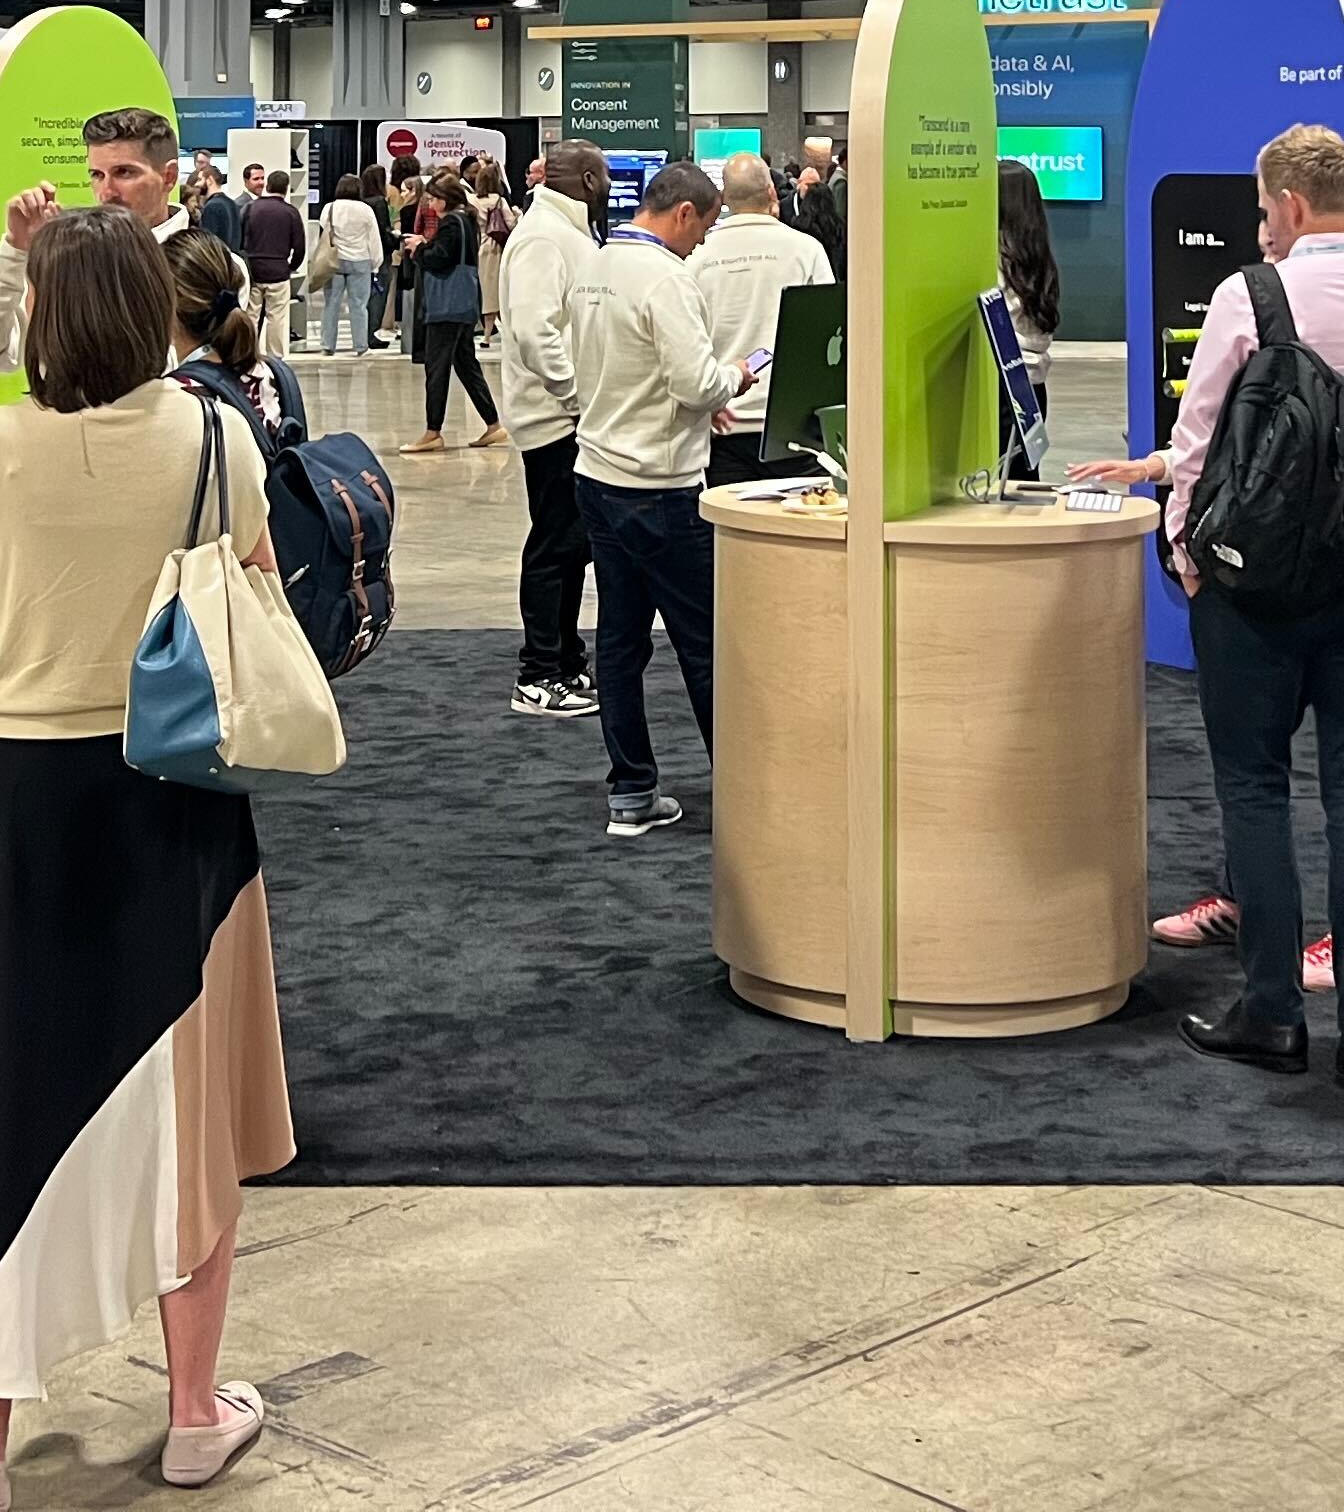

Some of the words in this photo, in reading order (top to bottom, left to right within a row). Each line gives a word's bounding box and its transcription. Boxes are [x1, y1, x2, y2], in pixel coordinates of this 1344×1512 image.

[1033, 55, 1048, 72] &
[1051, 55, 1075, 73] AI,
[1279, 66, 1297, 82] Be
[1299, 65, 1326, 84] part
[1328, 65, 1343, 81] of
[570, 81, 621, 89] INNOVATION
[621, 81, 631, 89] IN
[993, 80, 1054, 100] onsibly
[570, 97, 628, 112] Consent
[570, 116, 660, 133] Management
[423, 139, 466, 150] Identity
[1178, 228, 1184, 245] I
[1185, 232, 1205, 246] am
